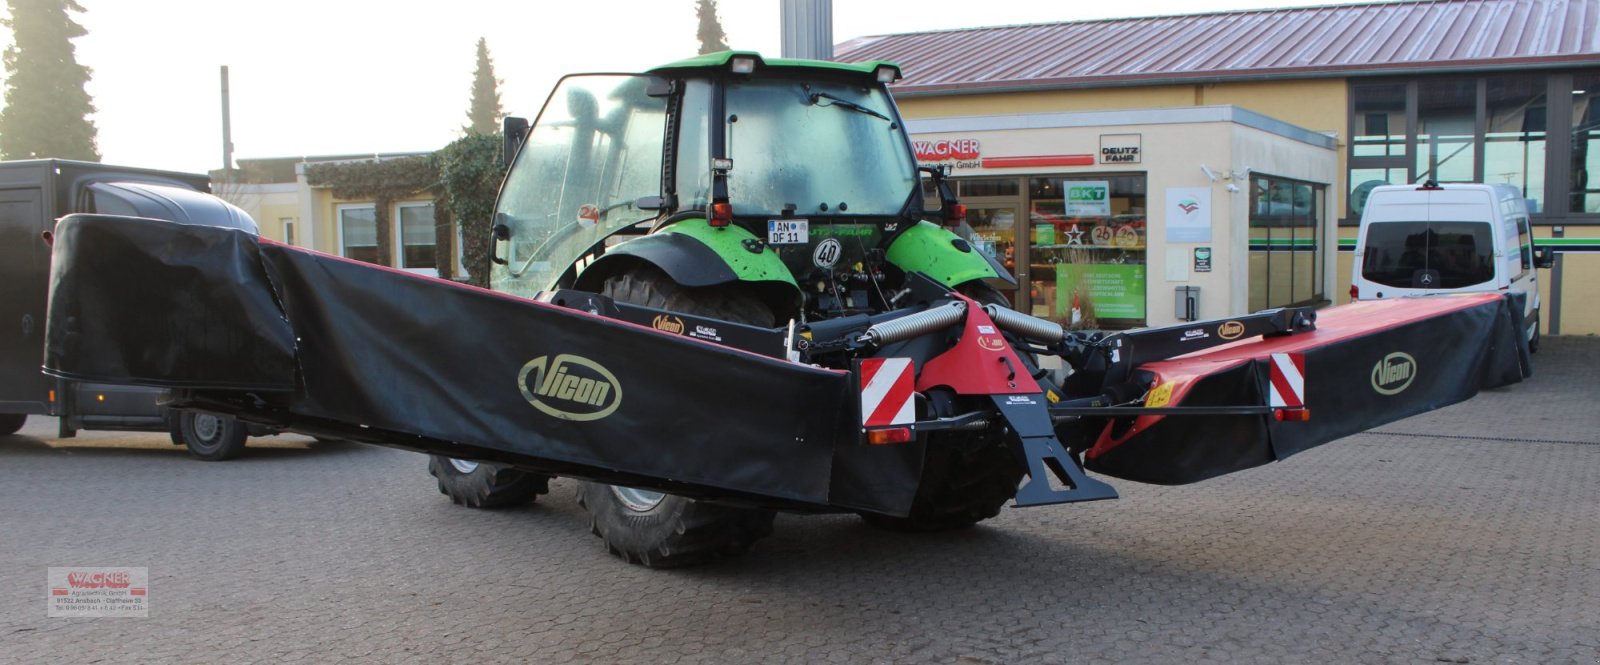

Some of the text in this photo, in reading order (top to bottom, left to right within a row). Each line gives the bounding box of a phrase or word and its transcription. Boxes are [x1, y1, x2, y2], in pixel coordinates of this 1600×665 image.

[912, 139, 980, 159] WAGNER
[1102, 147, 1138, 155] DEUTZ
[1105, 154, 1134, 162] FAHR
[957, 161, 981, 169] GmbH
[1070, 188, 1105, 199] BKT
[777, 223, 790, 232] AN
[773, 232, 799, 243] DF 11
[818, 245, 836, 263] 40
[655, 315, 682, 333] Vicon
[1220, 322, 1243, 337] Vicon
[1375, 353, 1412, 388] Vicon
[528, 354, 612, 408] Vicon
